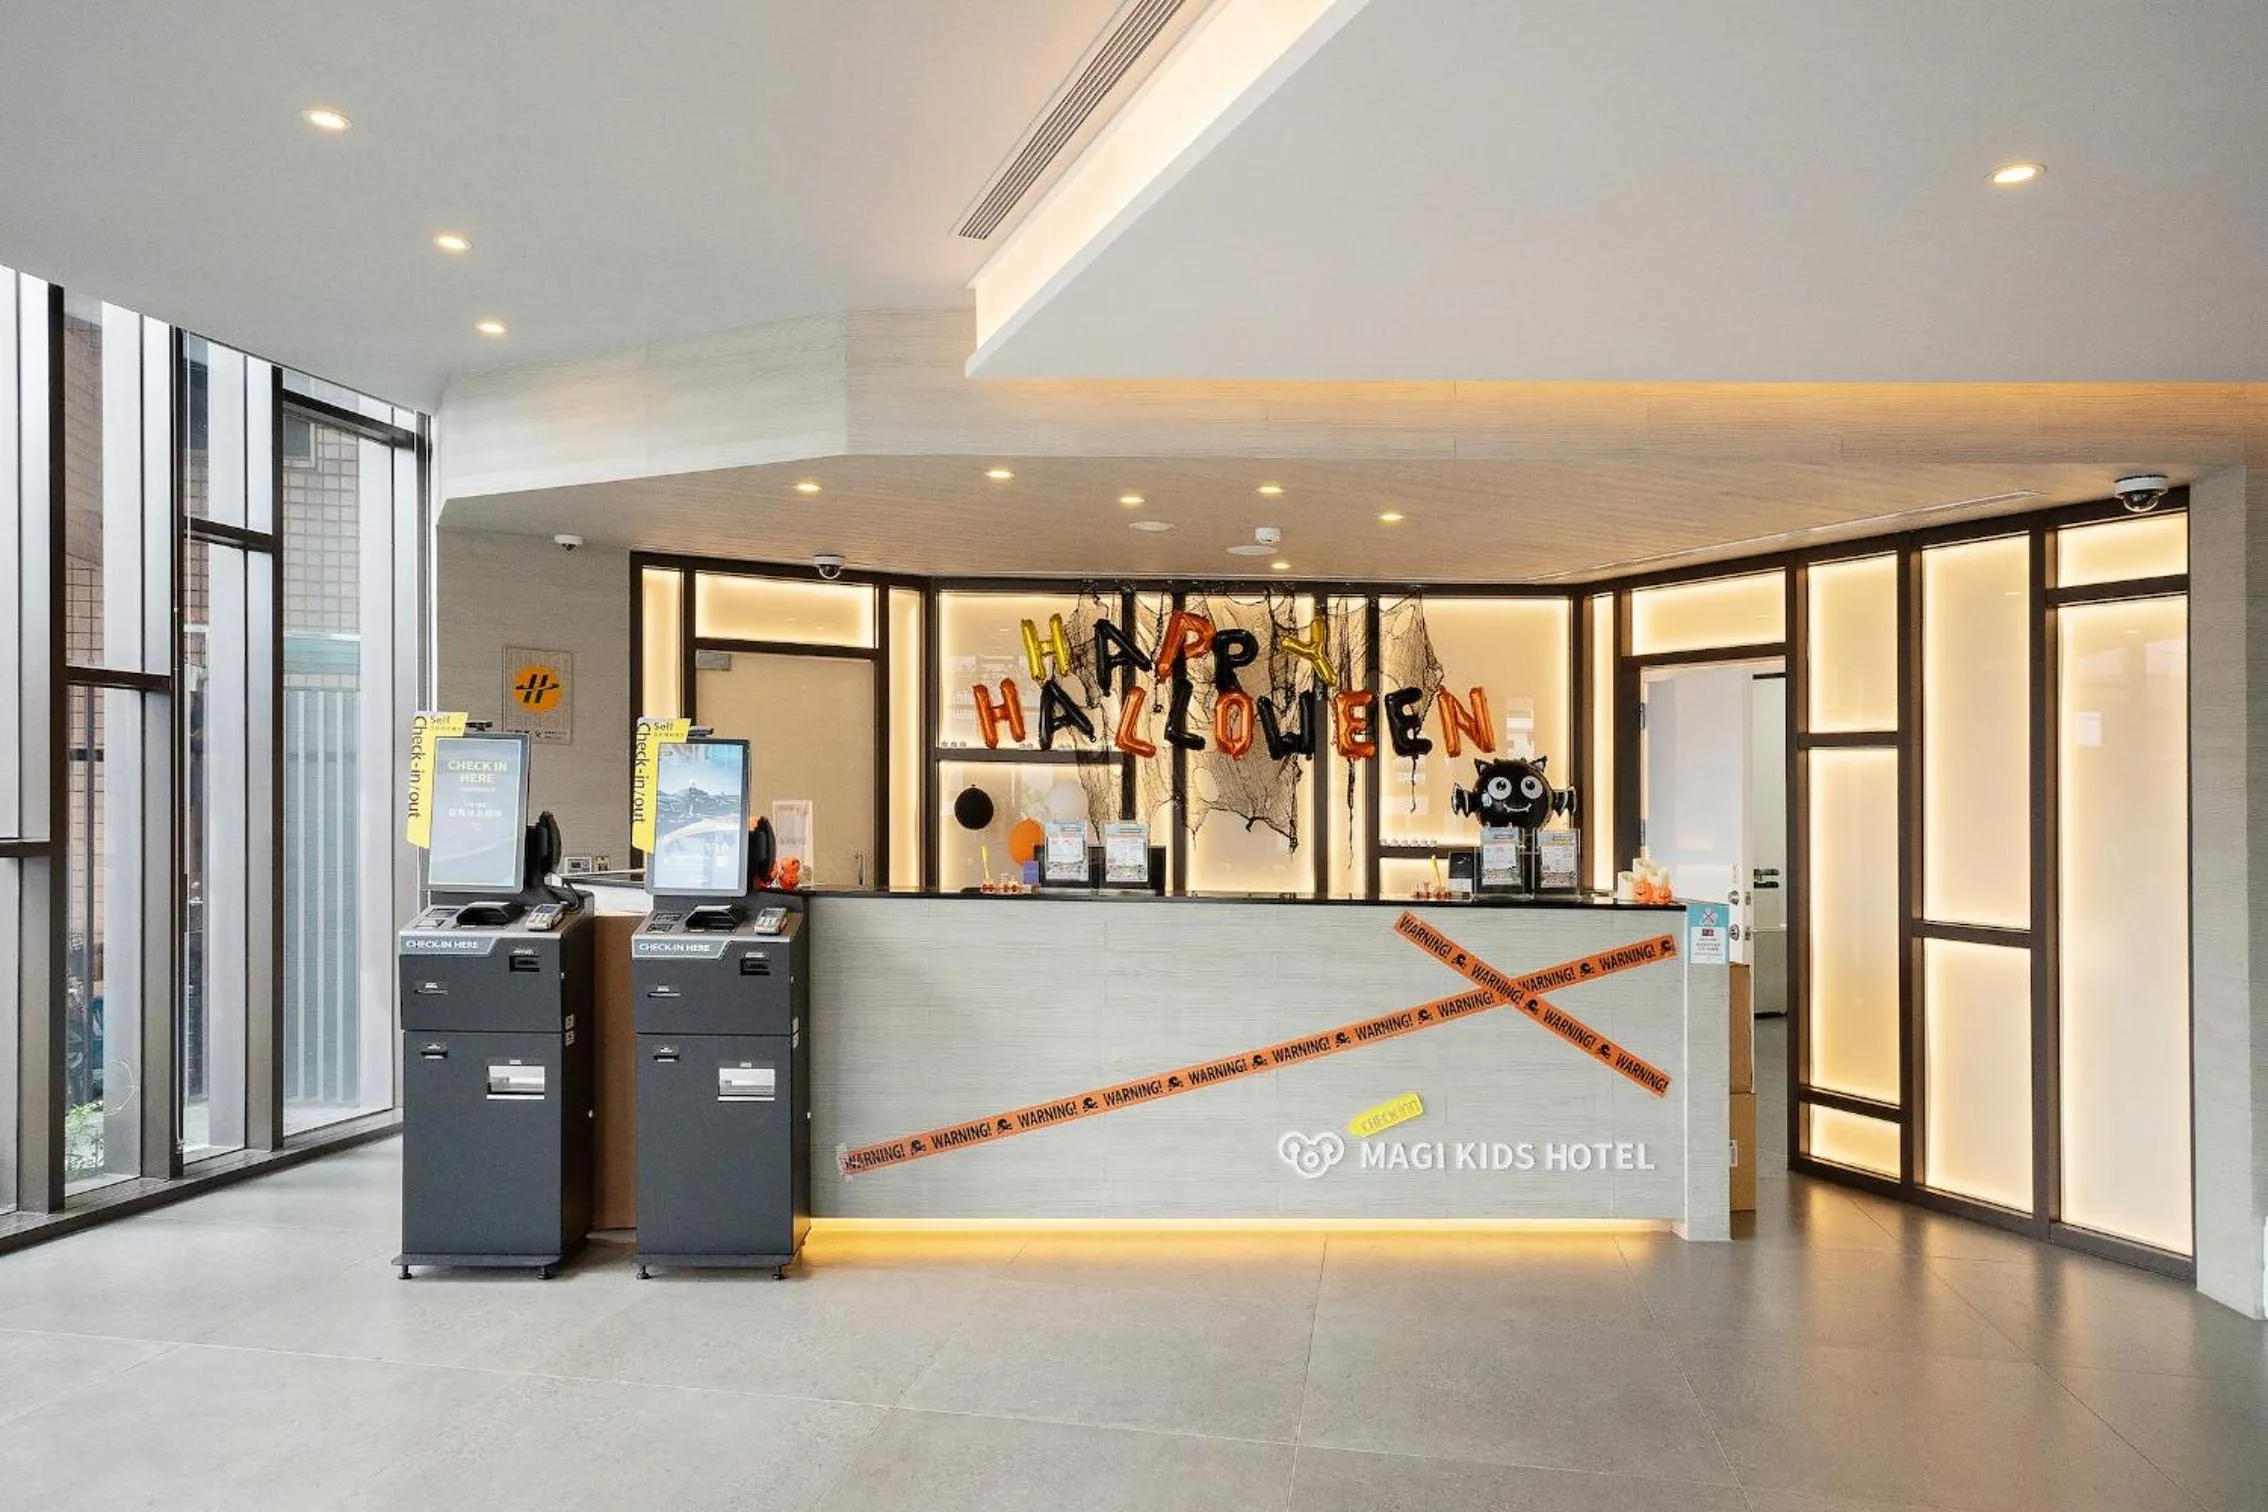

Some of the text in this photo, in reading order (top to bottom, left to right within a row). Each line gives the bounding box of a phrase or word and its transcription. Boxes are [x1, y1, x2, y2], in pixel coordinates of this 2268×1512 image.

[1020, 610, 1338, 697] HAPPY
[430, 714, 451, 725] Self
[653, 721, 675, 731] Self
[972, 676, 1496, 760] HALLOWEEN
[407, 715, 428, 818] Check-in/out
[448, 760, 493, 772] CHECK
[460, 773, 496, 784] HERE
[633, 722, 652, 823] Check-in/out
[454, 941, 479, 950] HERE
[686, 944, 712, 953] HERE
[1400, 916, 1669, 1094] WARNING! WARNING! WARNING! WARNING!
[844, 1144, 906, 1170] WARNING!
[931, 1122, 993, 1149] WARNING!
[1018, 1101, 1078, 1128] WARNING!
[1103, 1080, 1164, 1106] WARNING!
[1188, 1058, 1248, 1085] WARNING!
[1272, 1037, 1332, 1063] WARNING!
[1355, 1014, 1414, 1041] WARNING!
[1437, 991, 1495, 1018] WARNING!
[1598, 944, 1657, 972] WARNING!
[1360, 1141, 1656, 1171] MAGI KIDS HOTEL
